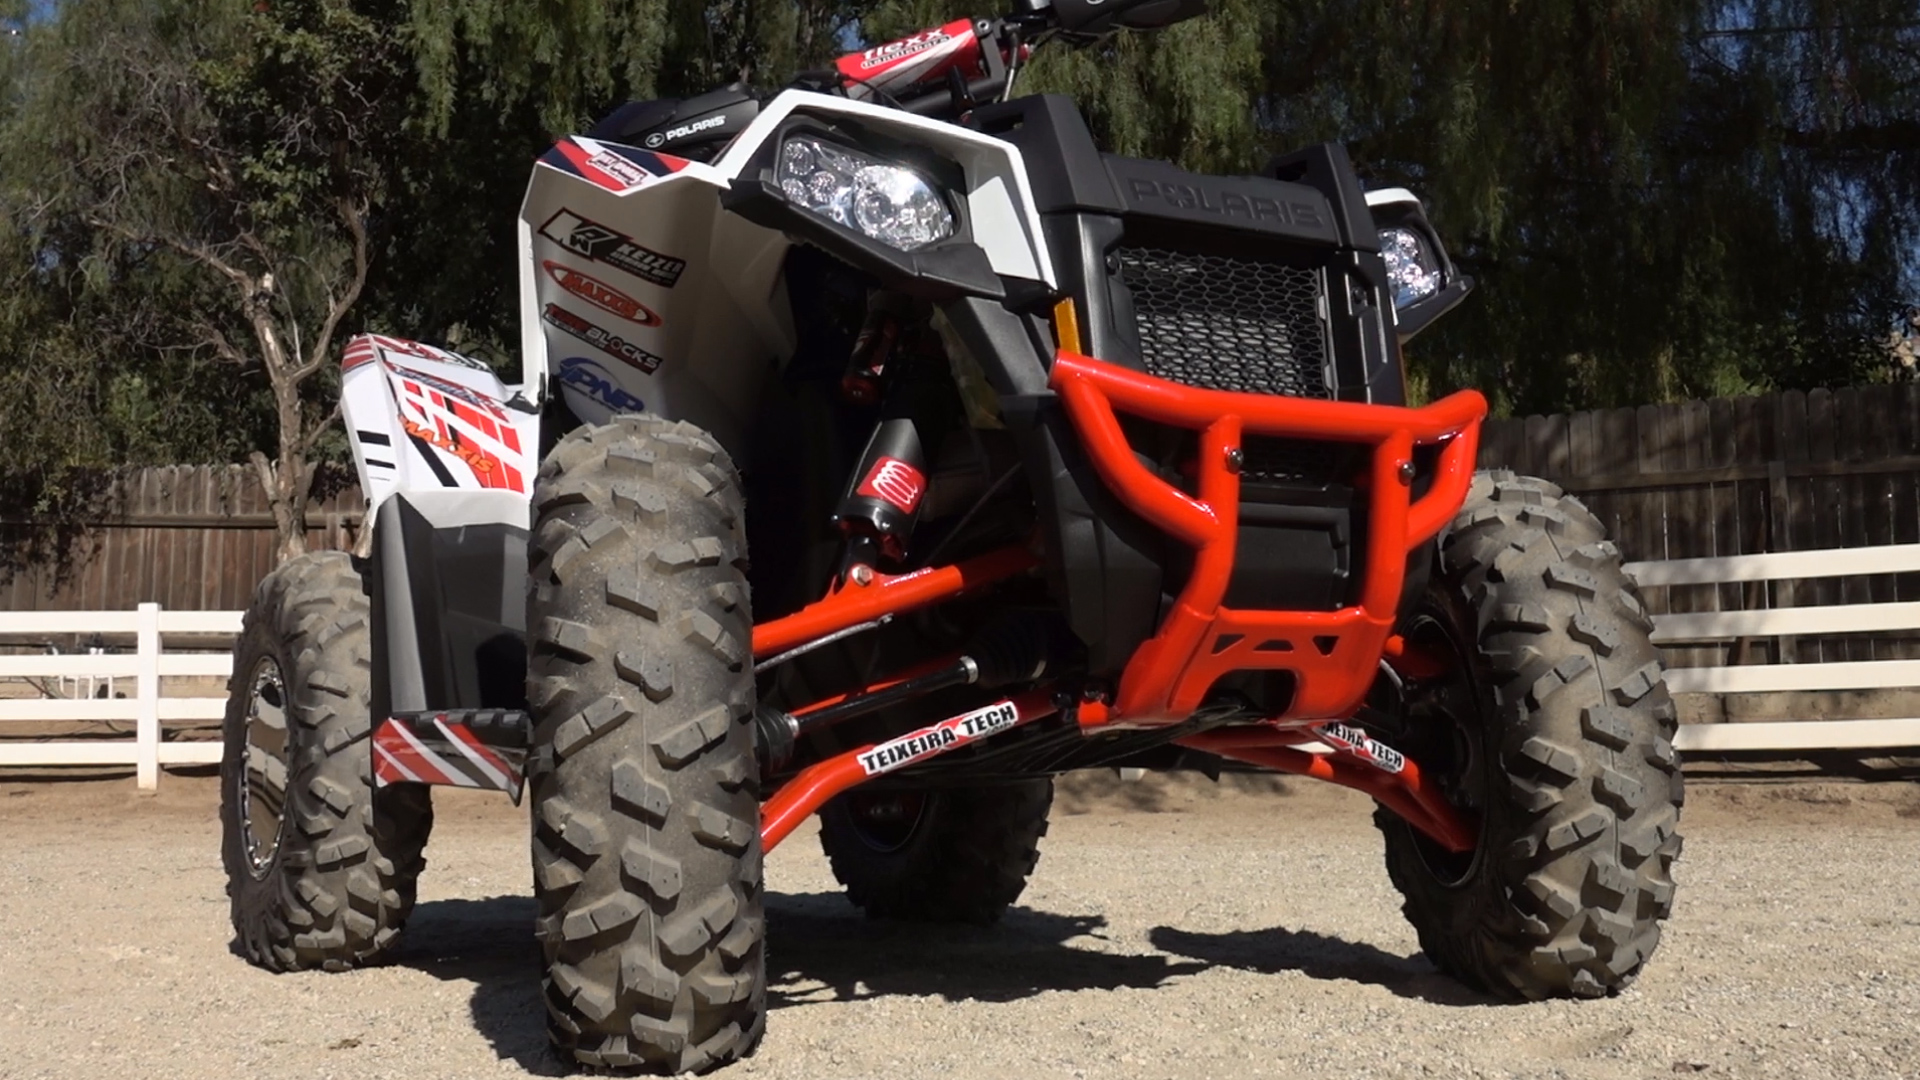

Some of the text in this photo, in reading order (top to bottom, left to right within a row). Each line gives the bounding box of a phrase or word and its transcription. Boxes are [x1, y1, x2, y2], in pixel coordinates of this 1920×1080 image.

[666, 115, 726, 140] POLARIS
[1127, 177, 1325, 229] POLARIS
[616, 243, 683, 273] KEIZER
[560, 271, 638, 319] MAXXIS
[398, 413, 494, 473] MAXXIS
[862, 705, 1015, 771] TEIXEIRA TECH
[1371, 741, 1402, 768] TECH
